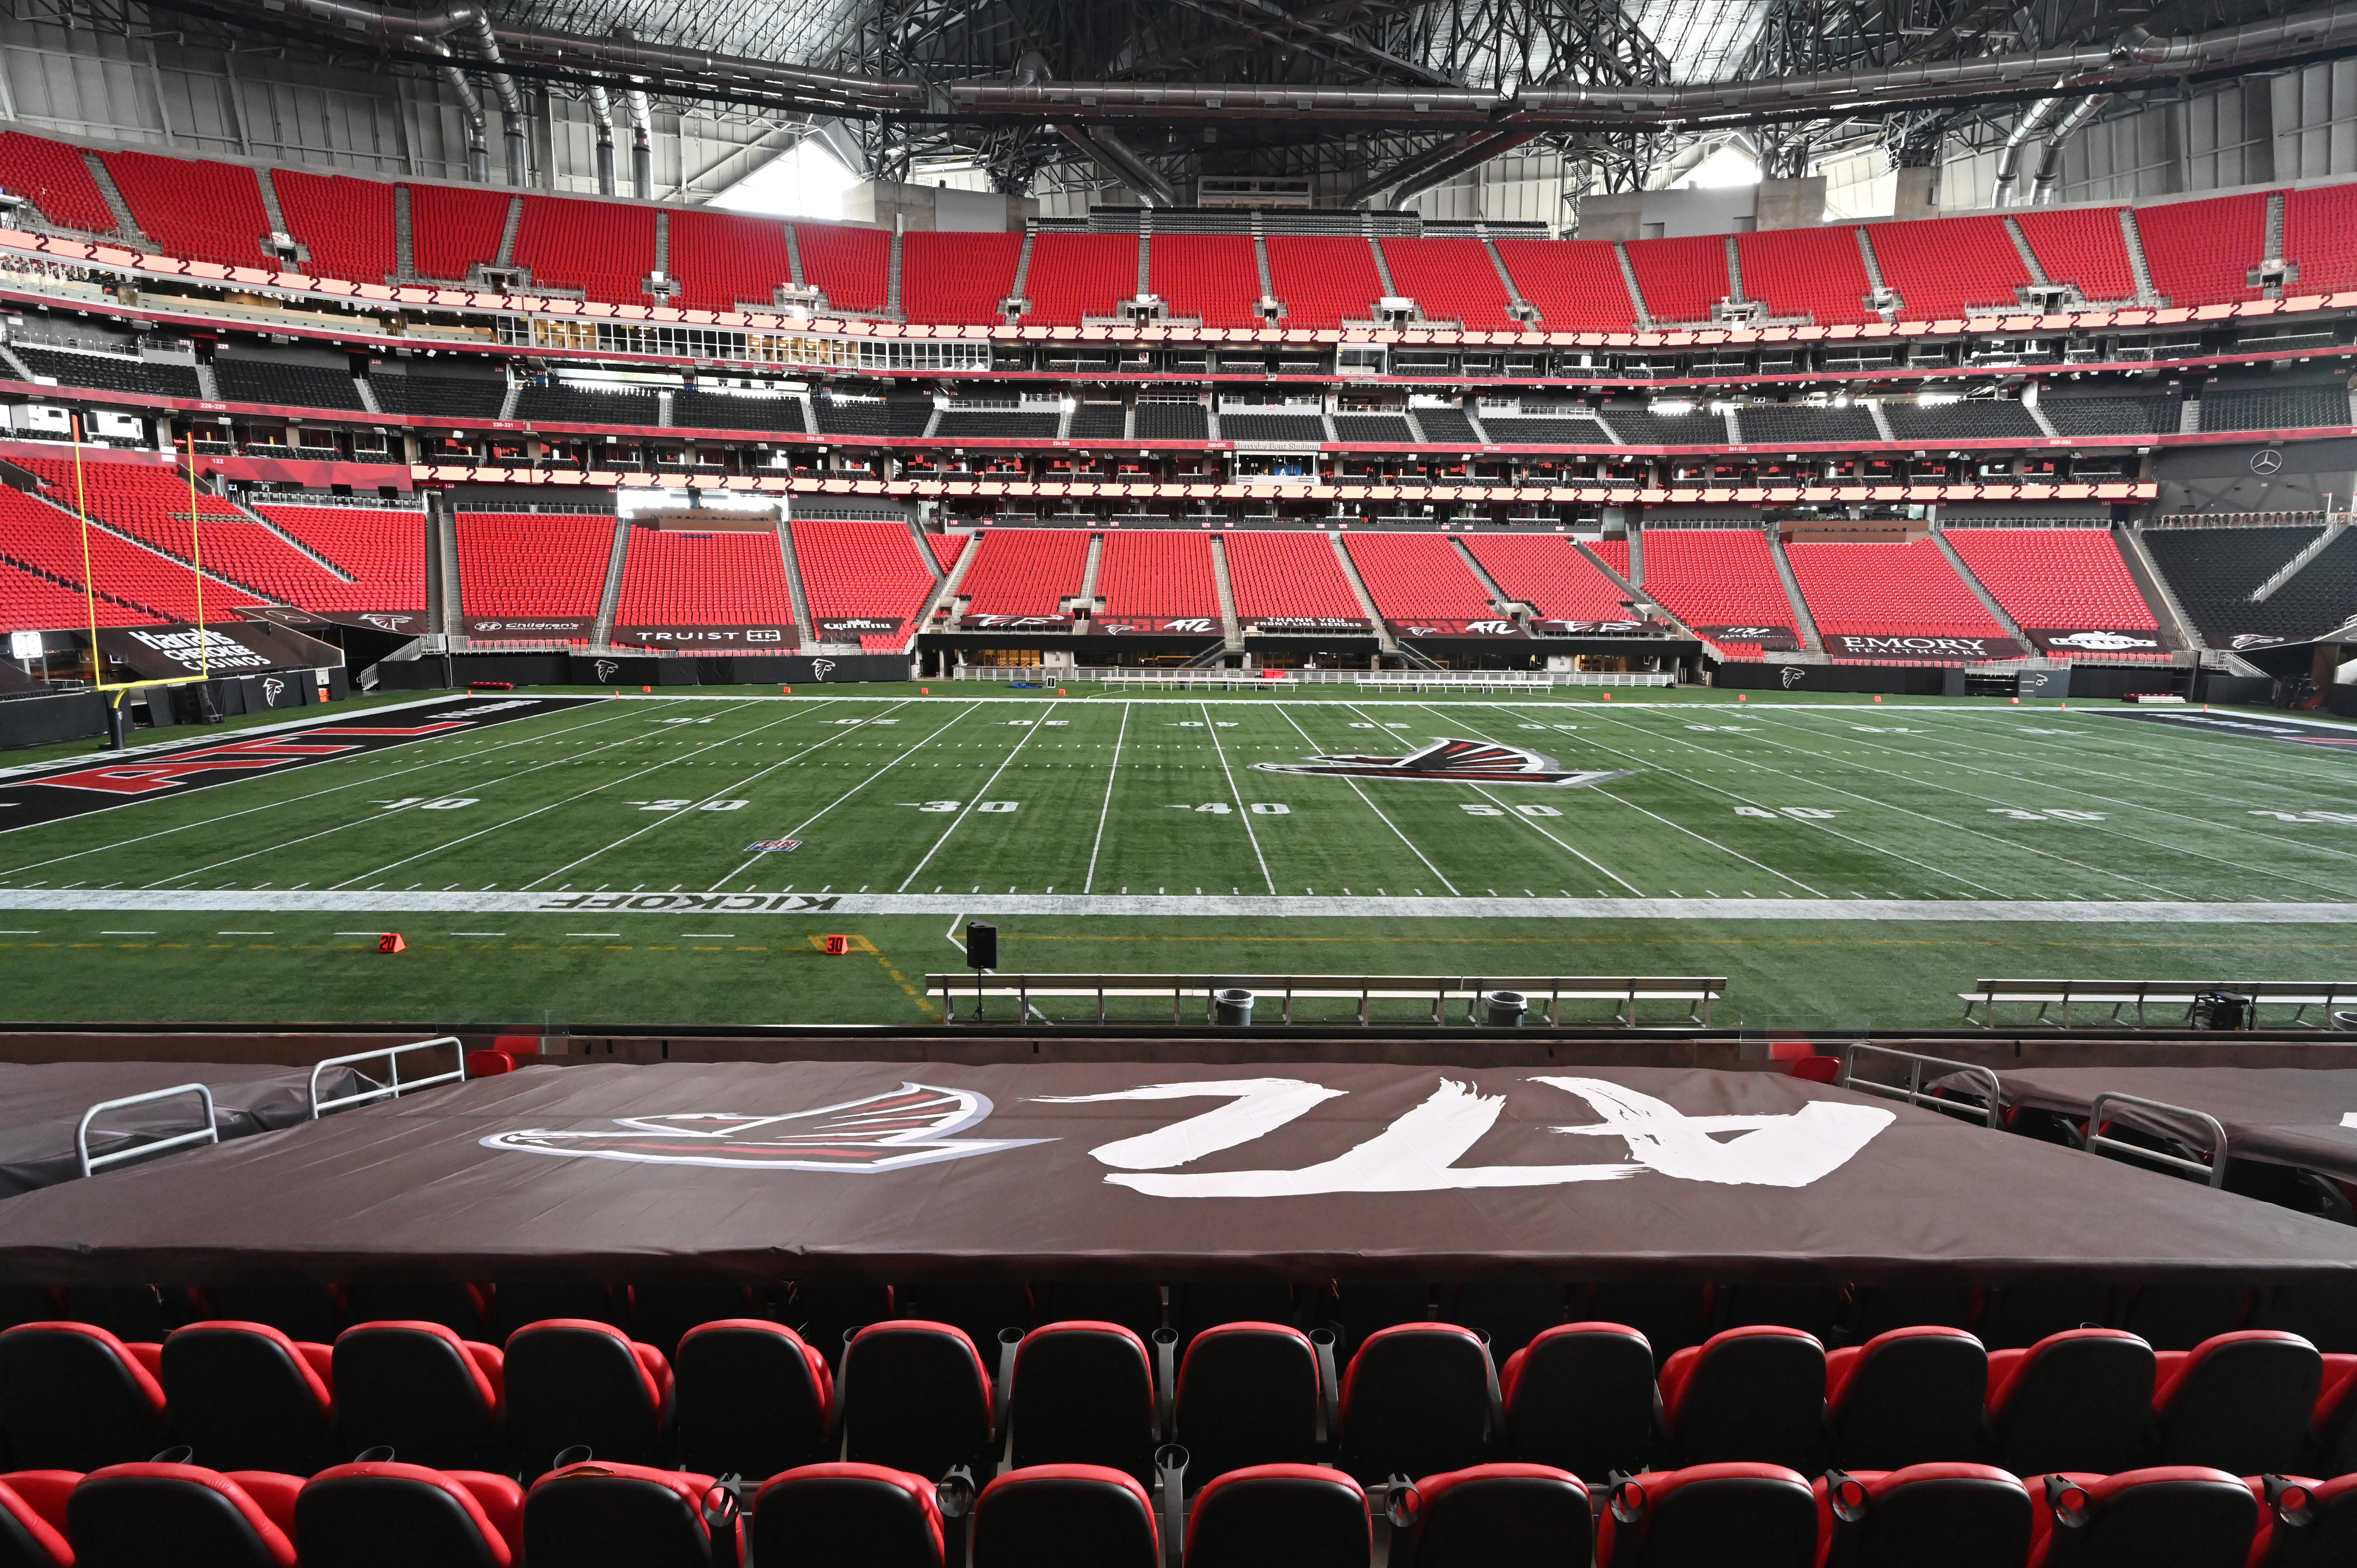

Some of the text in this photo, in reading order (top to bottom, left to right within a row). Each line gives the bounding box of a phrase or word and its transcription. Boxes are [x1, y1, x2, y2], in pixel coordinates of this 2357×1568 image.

[35, 237, 2199, 345] 2 2 2 2 2 2 2 2 2 2 2 2 2 2 2 2 2
[1235, 441, 1287, 449] Mercedes-Benz
[428, 466, 2022, 501] 2 2 2 2 2 2 2 2 2 2 2 2 2 2
[1164, 619, 1216, 632] ATL
[1465, 621, 1518, 635] ATL
[1841, 637, 1984, 649] EMORY
[163, 645, 255, 661] CHEROKEE
[183, 655, 271, 671] CASINOS
[9, 757, 107, 770] END
[381, 798, 480, 809] 10
[638, 800, 750, 810] 20
[919, 801, 1019, 812] 30
[1195, 803, 1291, 814] 40
[1458, 805, 1563, 815] 50
[1734, 807, 1835, 818] 40
[1986, 809, 2106, 820] 30
[2248, 811, 2357, 822] 20
[539, 895, 842, 910] KICKOFF
[379, 935, 396, 951] 20
[827, 937, 843, 953] 30
[1019, 1076, 1898, 1198] ATL
